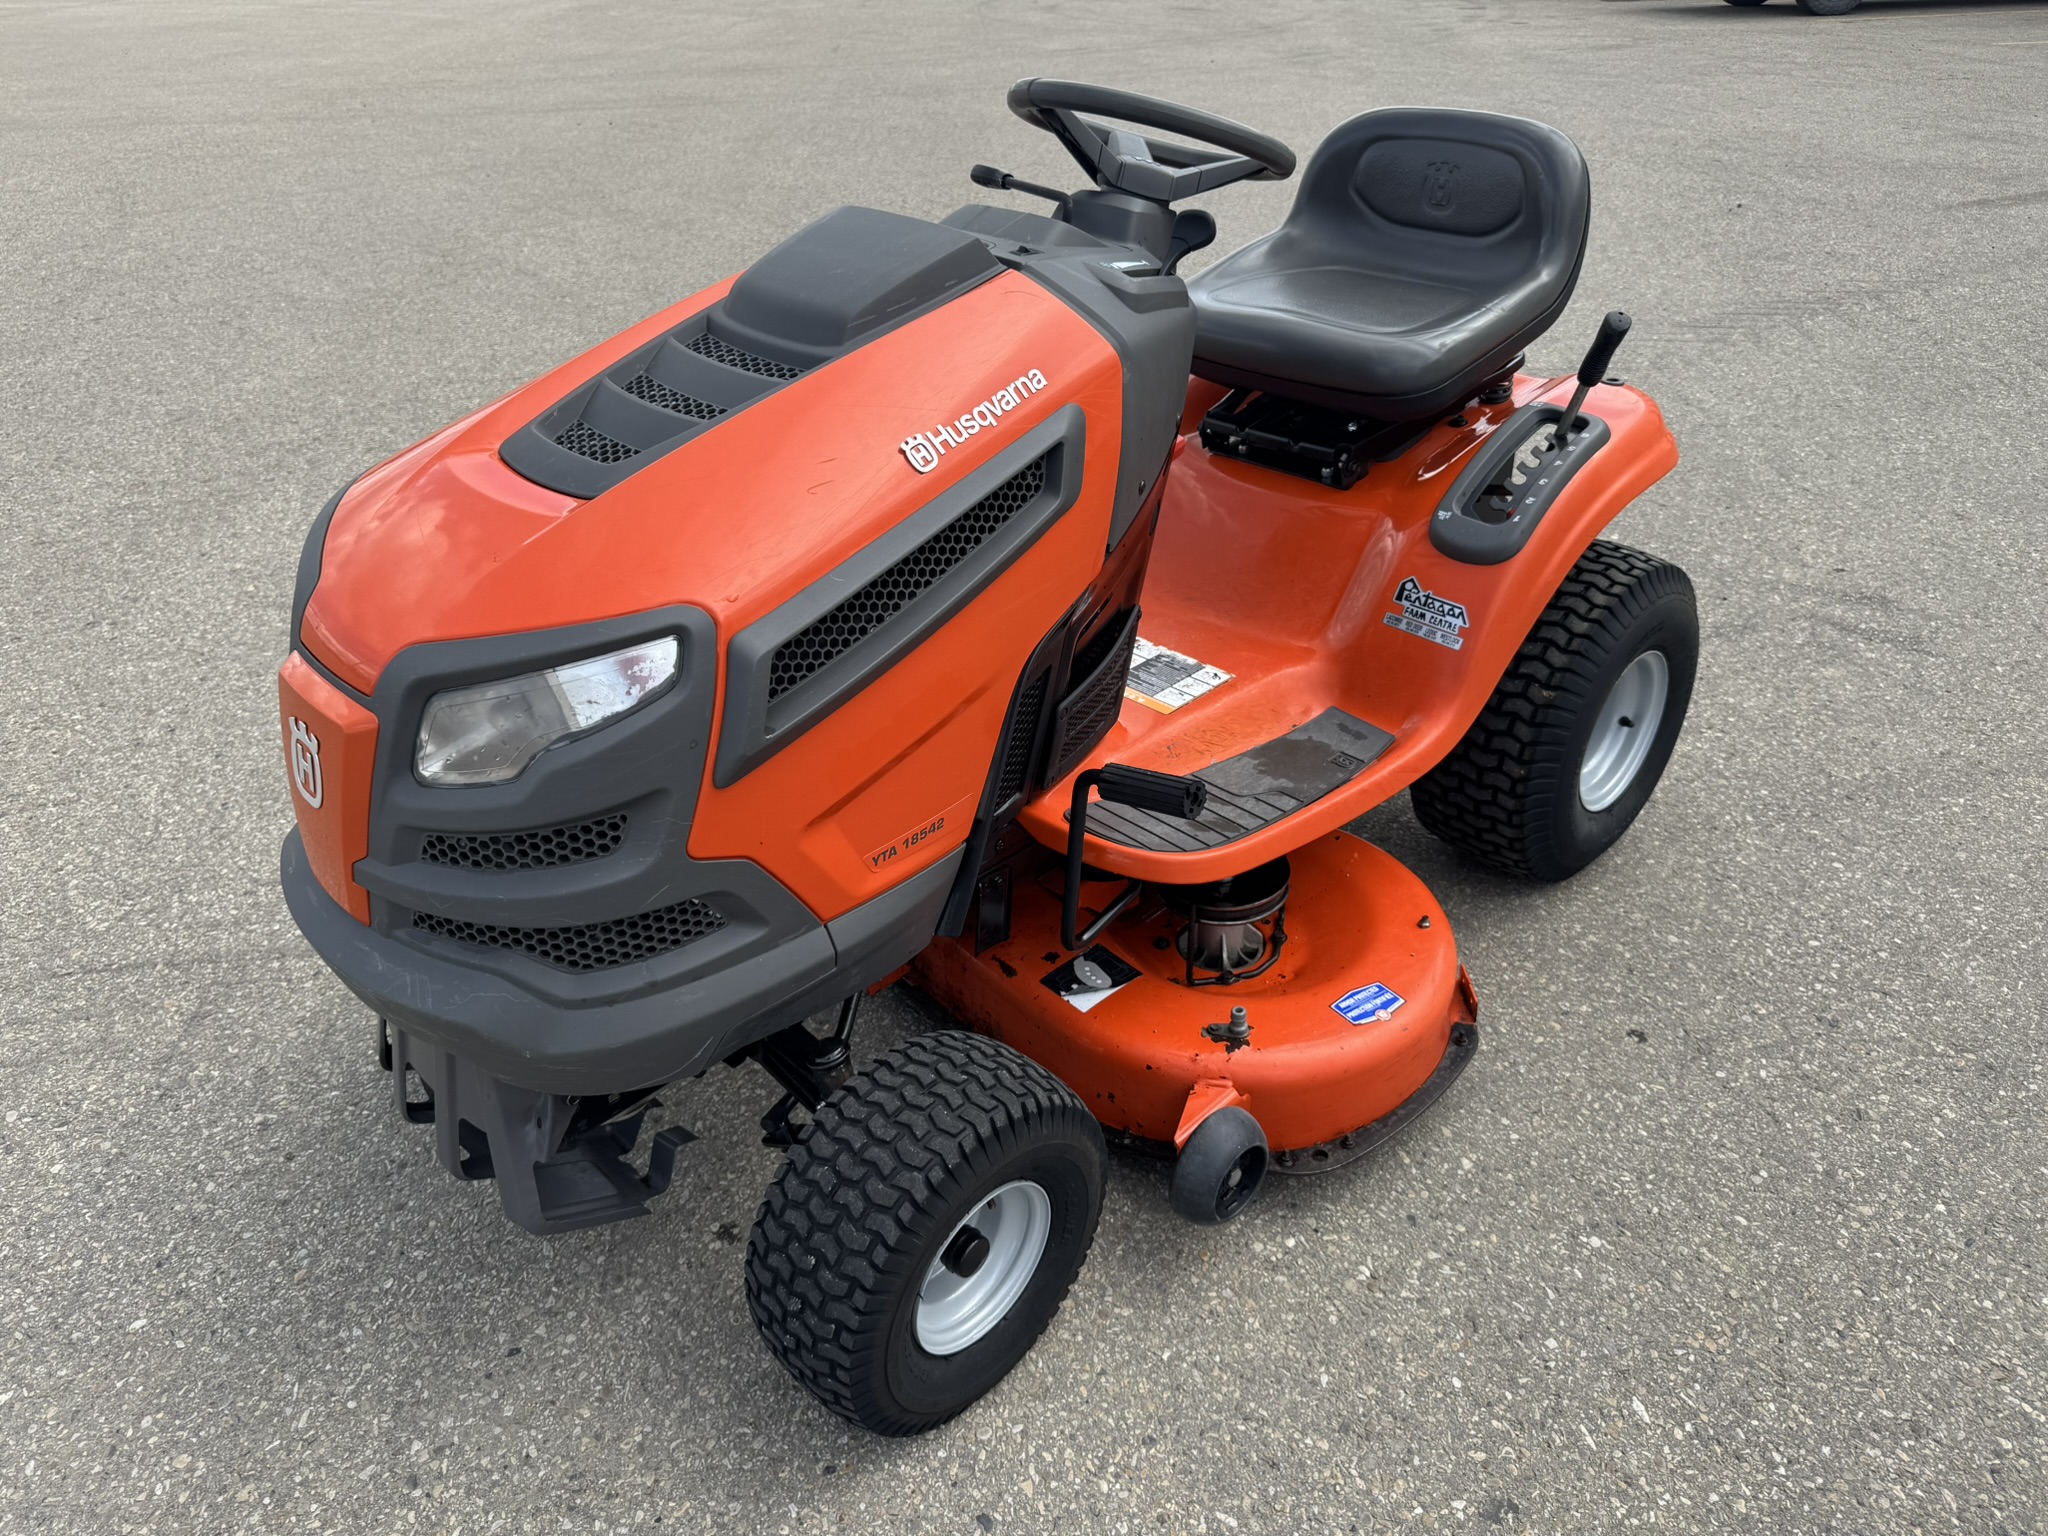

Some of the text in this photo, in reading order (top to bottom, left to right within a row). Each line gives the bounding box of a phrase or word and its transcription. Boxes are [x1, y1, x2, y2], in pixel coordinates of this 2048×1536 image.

[925, 368, 1048, 455] Husqvarna
[1404, 607, 1426, 621] FARM
[1428, 616, 1458, 632] CENTRE
[871, 817, 945, 867] YTA 18542
